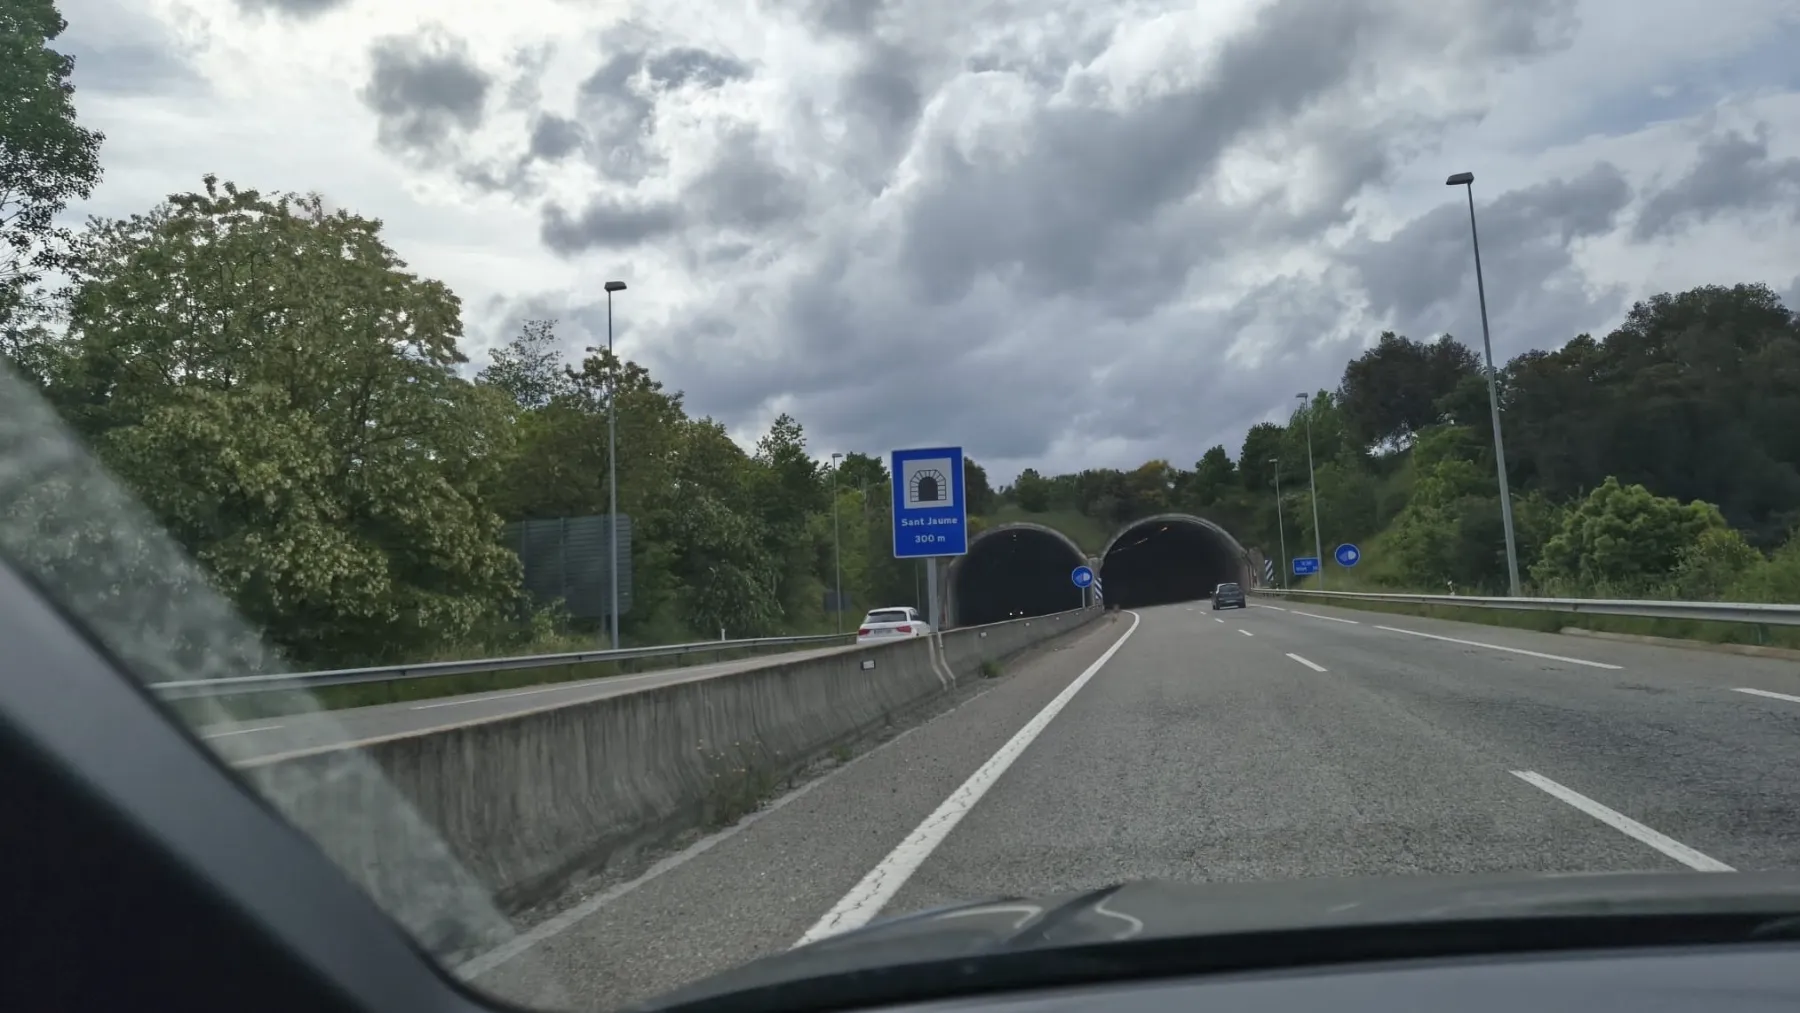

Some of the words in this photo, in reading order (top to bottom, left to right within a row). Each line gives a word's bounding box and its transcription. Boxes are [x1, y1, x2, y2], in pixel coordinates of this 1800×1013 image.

[901, 518, 925, 527] Sant
[927, 517, 958, 525] Jaume
[915, 534, 935, 543] 300
